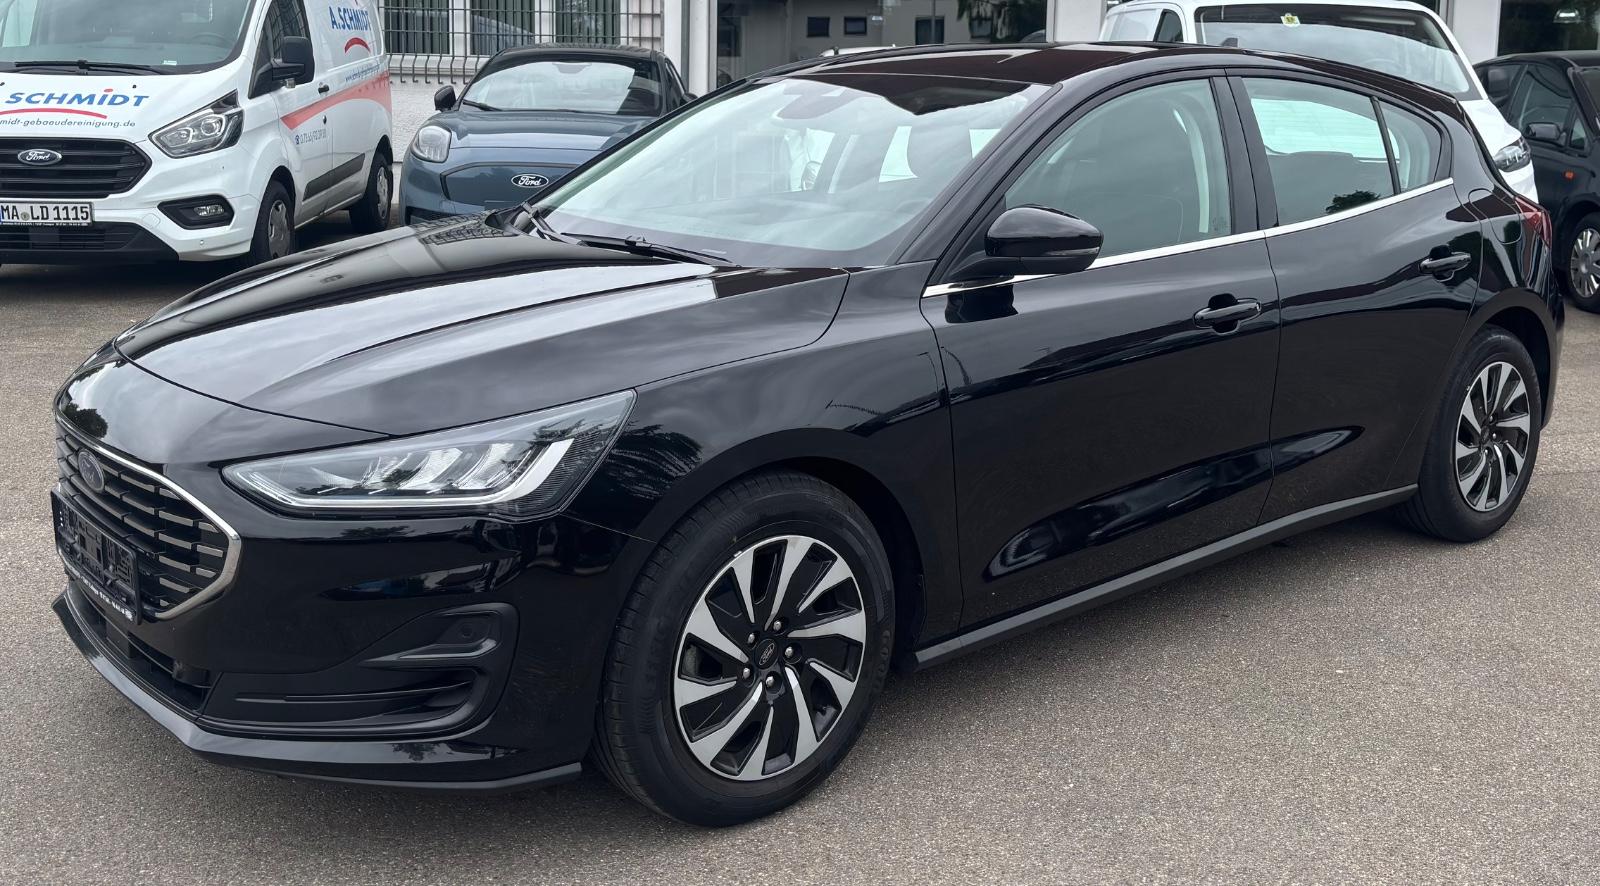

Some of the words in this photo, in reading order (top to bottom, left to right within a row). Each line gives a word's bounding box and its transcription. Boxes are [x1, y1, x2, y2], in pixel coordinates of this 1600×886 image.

[26, 150, 51, 161] Ford
[518, 175, 542, 187] Ford
[0, 205, 20, 220] MA
[30, 205, 50, 220] LD
[53, 205, 89, 220] 1115
